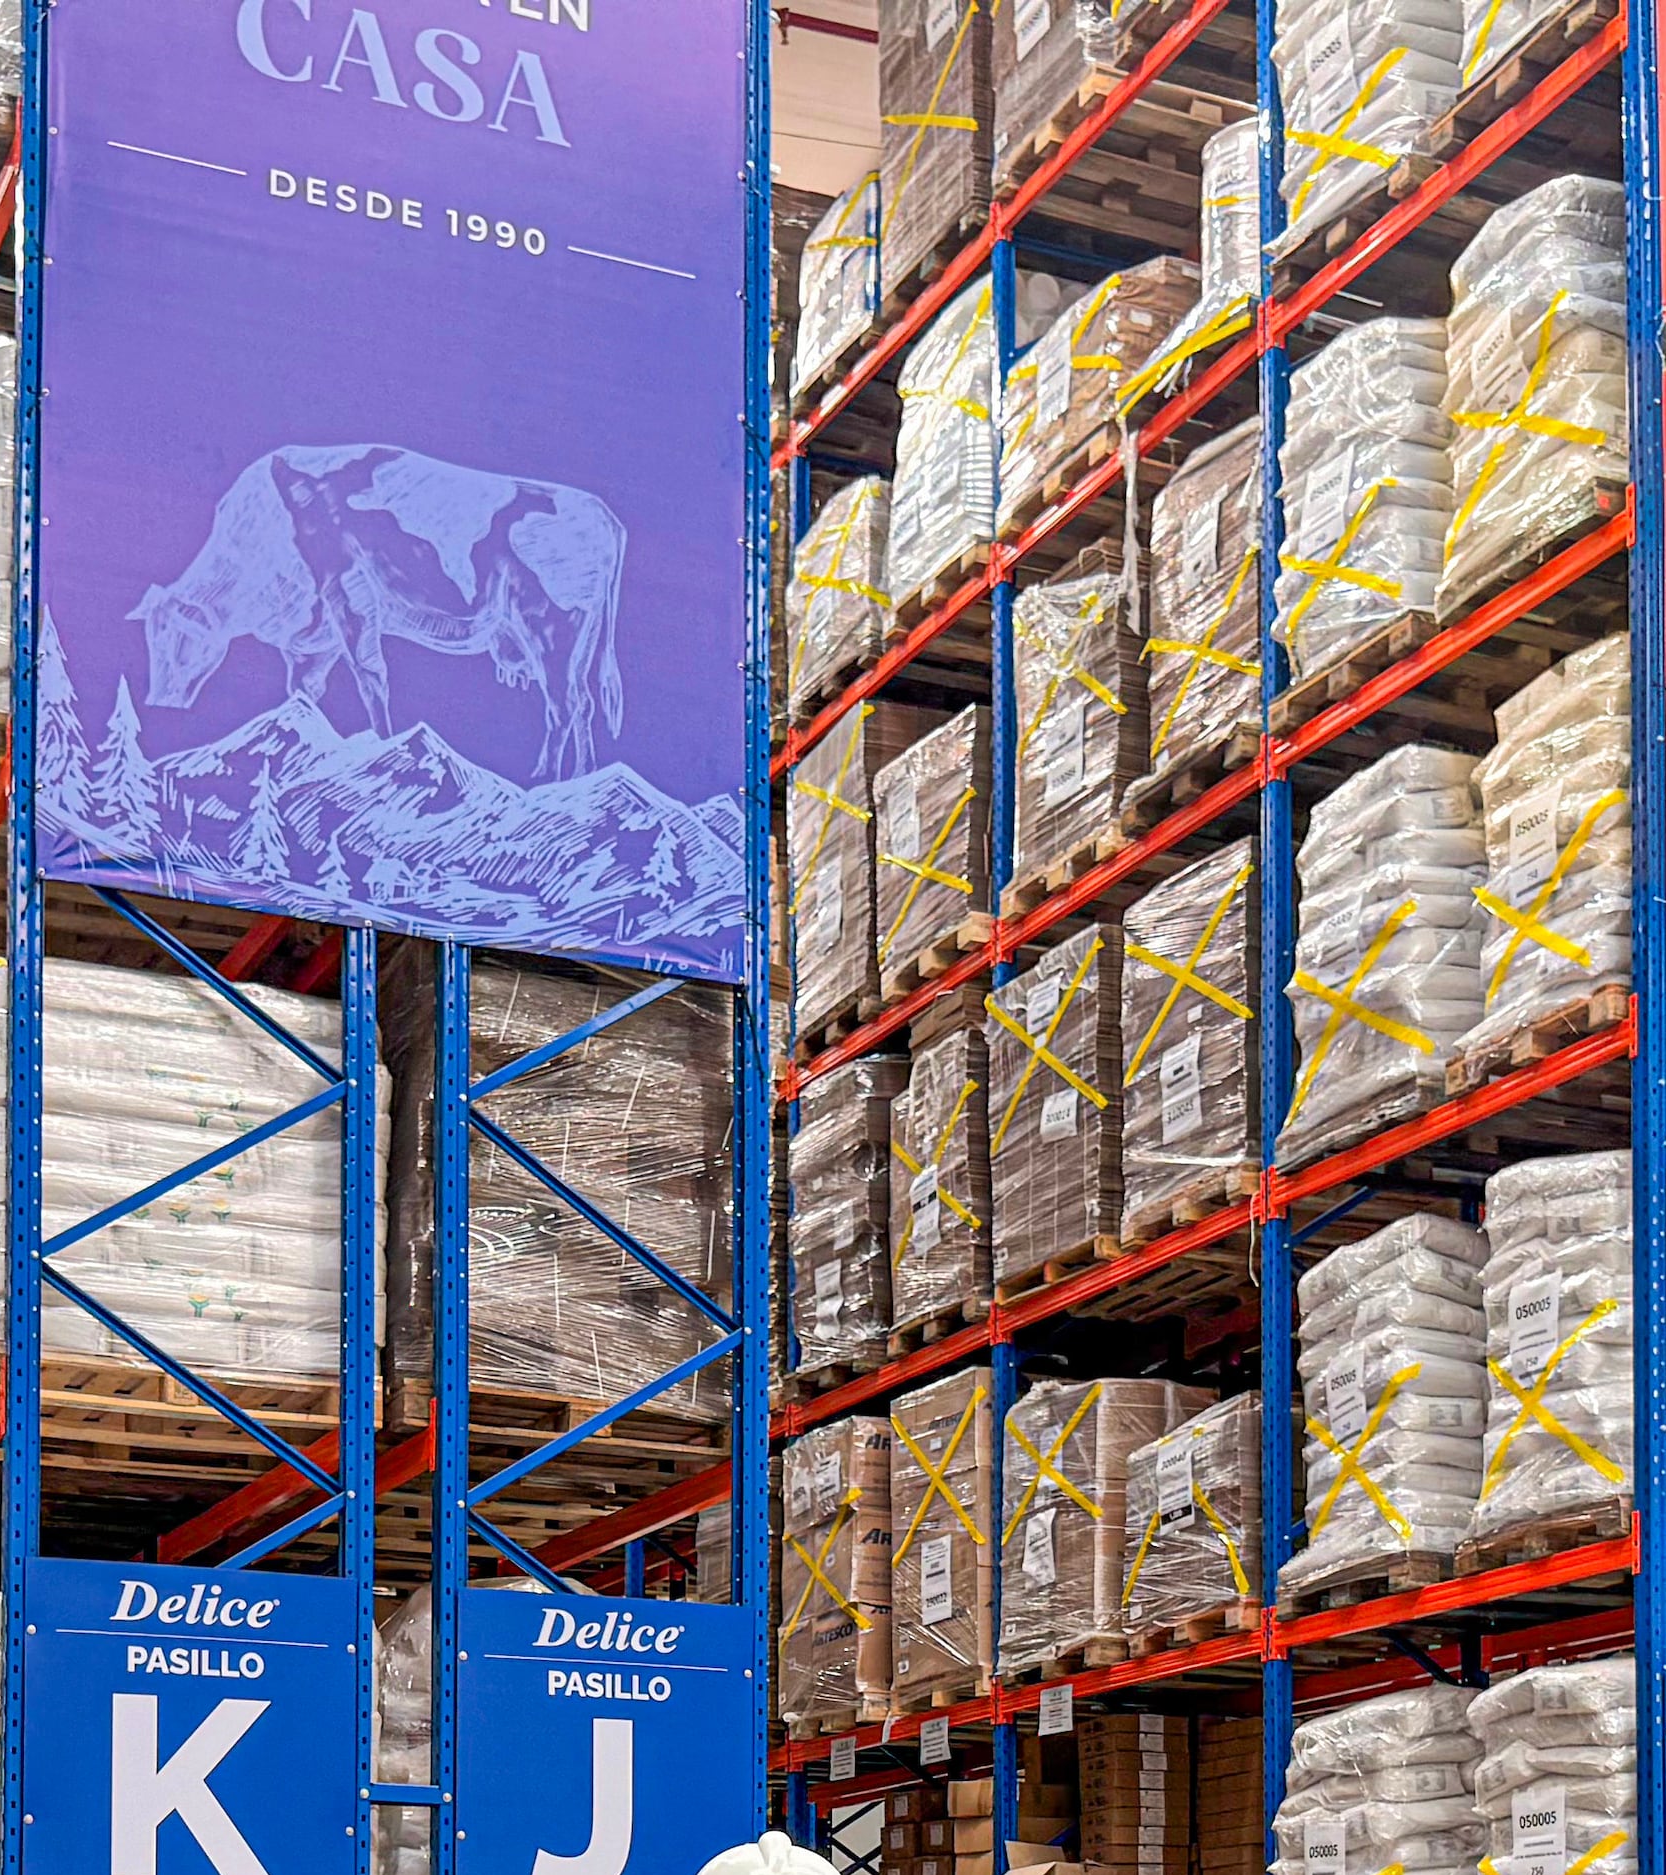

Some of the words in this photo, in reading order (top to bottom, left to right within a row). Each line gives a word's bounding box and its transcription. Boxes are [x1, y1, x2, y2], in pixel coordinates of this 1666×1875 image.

[237, 0, 571, 148] CASA
[270, 168, 424, 230] DESDE
[445, 208, 546, 256] 1990
[109, 1580, 274, 1628] Delice
[532, 1608, 680, 1654] Delice
[127, 1644, 265, 1679] PASILLO
[548, 1669, 672, 1703] PASILLO
[1519, 1810, 1557, 1830] 050005
